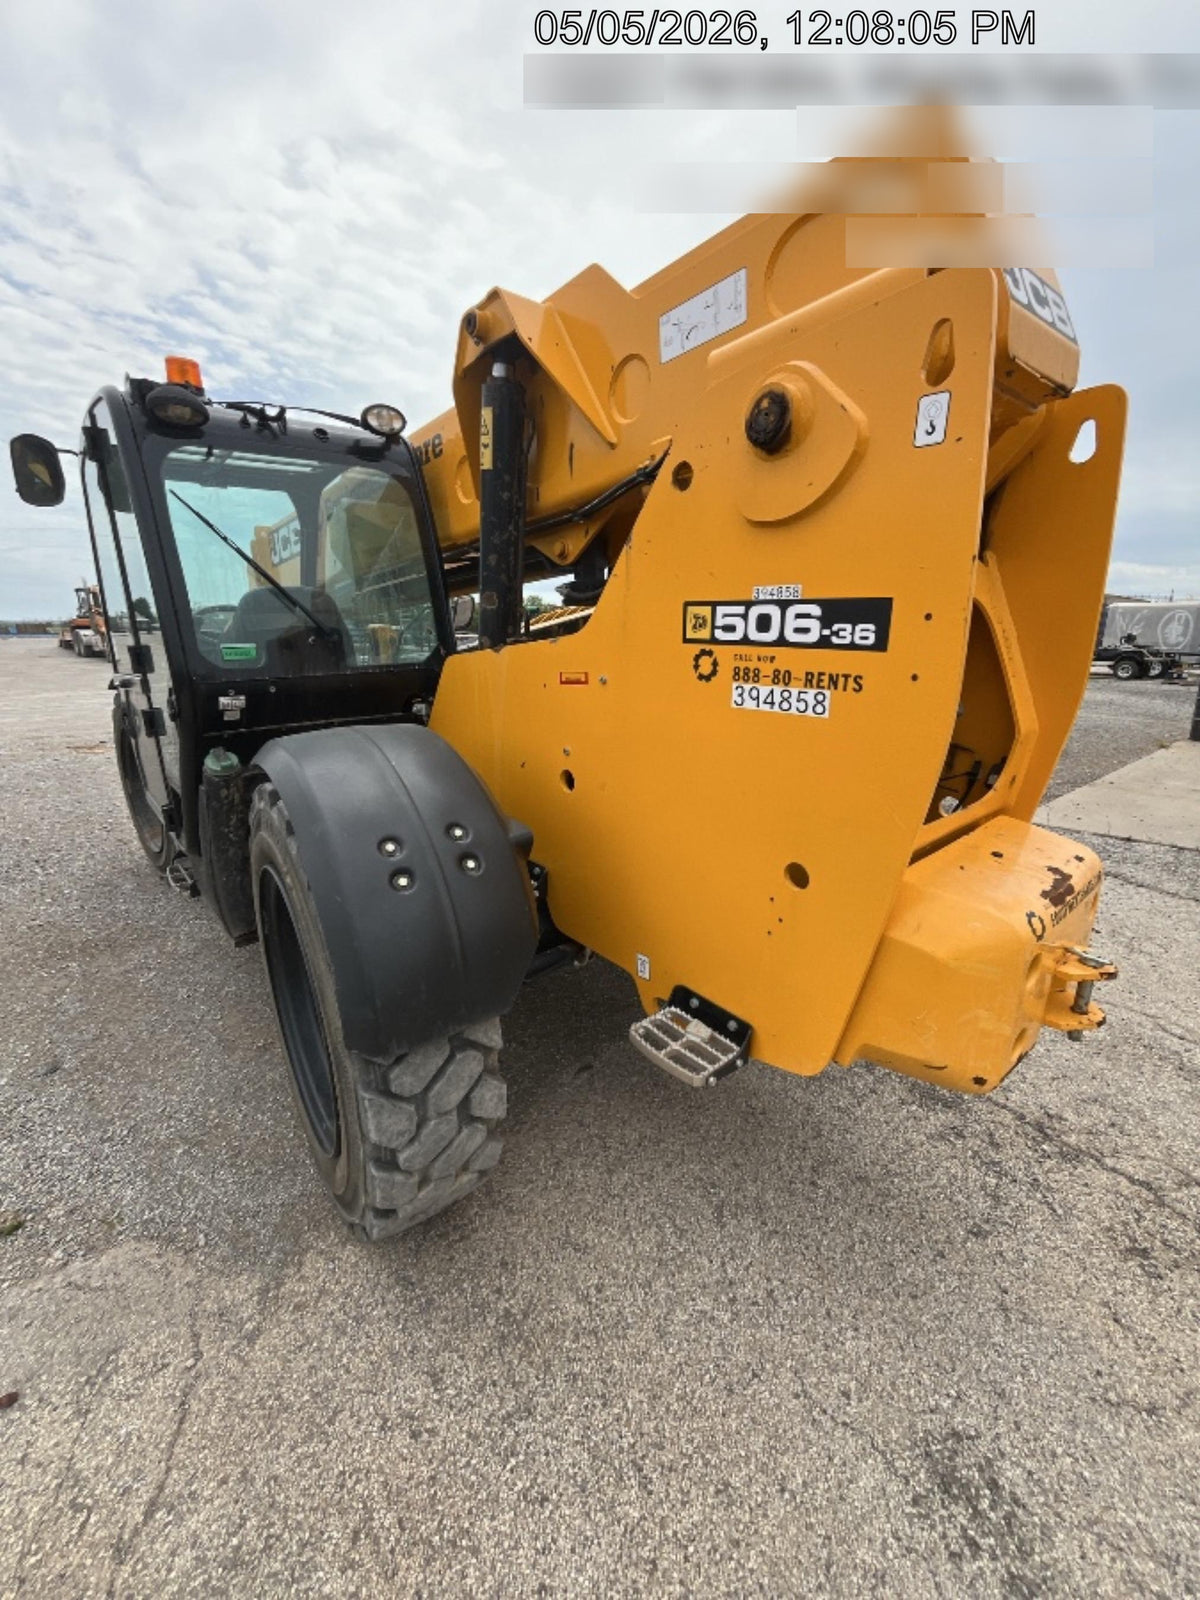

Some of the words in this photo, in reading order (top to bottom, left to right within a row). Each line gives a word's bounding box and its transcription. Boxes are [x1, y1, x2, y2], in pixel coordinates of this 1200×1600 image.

[1002, 268, 1076, 340] JCB
[714, 604, 876, 645] 506-36
[732, 666, 864, 693] 888-80-RENTS
[733, 685, 827, 715] 394858
